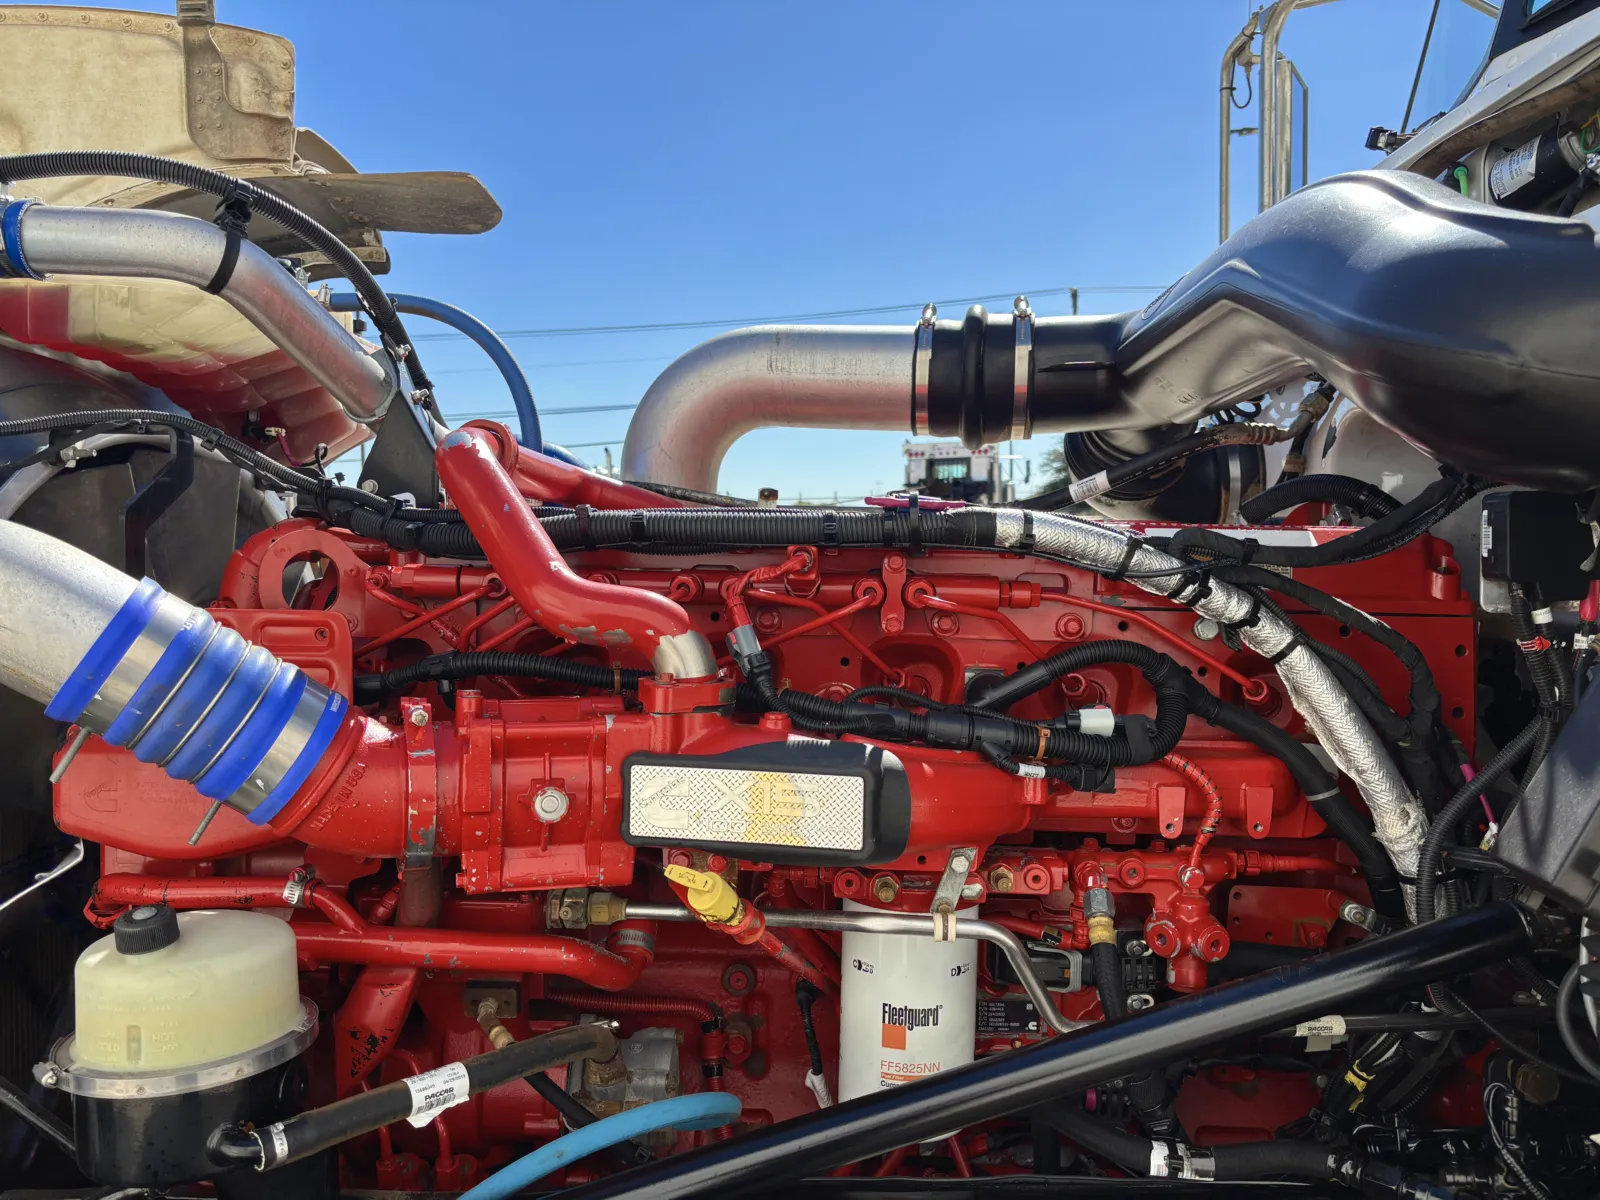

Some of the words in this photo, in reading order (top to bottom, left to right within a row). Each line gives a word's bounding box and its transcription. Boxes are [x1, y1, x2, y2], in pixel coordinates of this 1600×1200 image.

[882, 1002, 940, 1032] Fleetguard
[151, 1032, 175, 1043] HOT
[880, 1059, 941, 1074] FF5825NN
[425, 1087, 454, 1101] PACCAR
